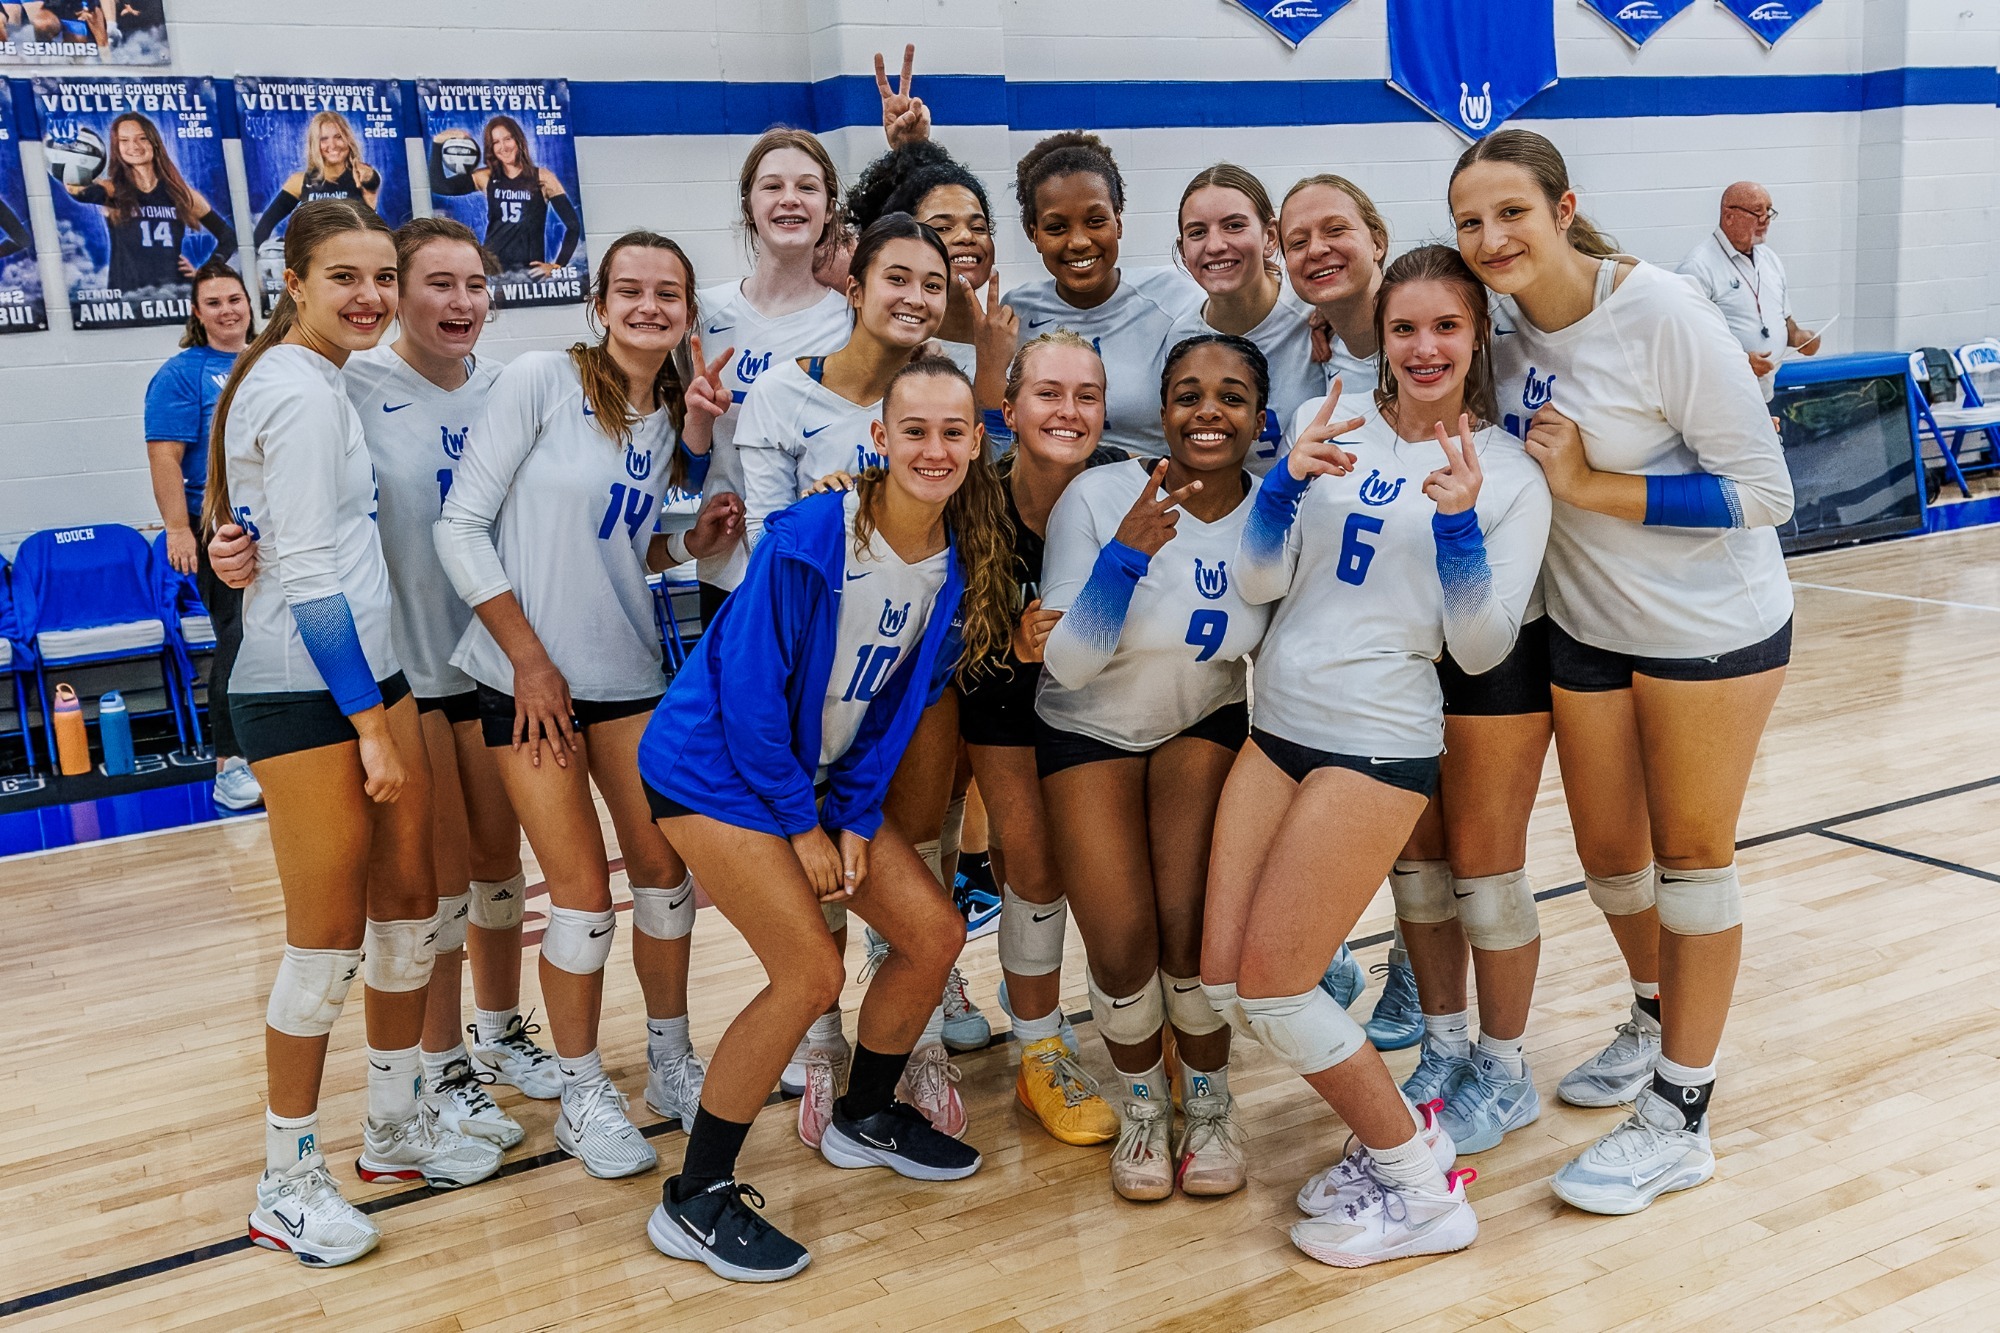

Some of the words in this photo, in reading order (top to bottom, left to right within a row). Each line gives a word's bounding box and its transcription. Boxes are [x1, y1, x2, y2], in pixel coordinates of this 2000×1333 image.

[1272, 8, 1296, 18] CHL
[22, 42, 98, 56] SENIORS
[59, 83, 122, 96] WYOMING
[125, 84, 187, 95] COWBOYS
[258, 83, 315, 95] WYOMING
[318, 85, 374, 97] COWBOYS
[439, 85, 490, 96] WYOMING
[494, 85, 545, 96] COWBOYS
[42, 94, 207, 112] VOLLEYBALL
[242, 93, 392, 112] VOLLEYBALL
[424, 94, 562, 111] VOLLEYBALL
[178, 113, 207, 121] CLASS
[177, 127, 213, 138] 2026
[364, 128, 397, 138] 2026
[535, 125, 567, 135] 2026
[131, 205, 177, 219] YOMIN
[500, 202, 522, 223] 15
[140, 220, 173, 247] 14
[551, 267, 577, 279] #15
[77, 288, 122, 301] SENIOR
[502, 281, 581, 300] WILLIAMS
[80, 302, 135, 323] ANNA
[598, 482, 654, 542] 14
[1336, 512, 1384, 586] 6
[1185, 608, 1228, 662] 9
[841, 644, 901, 702] 10
